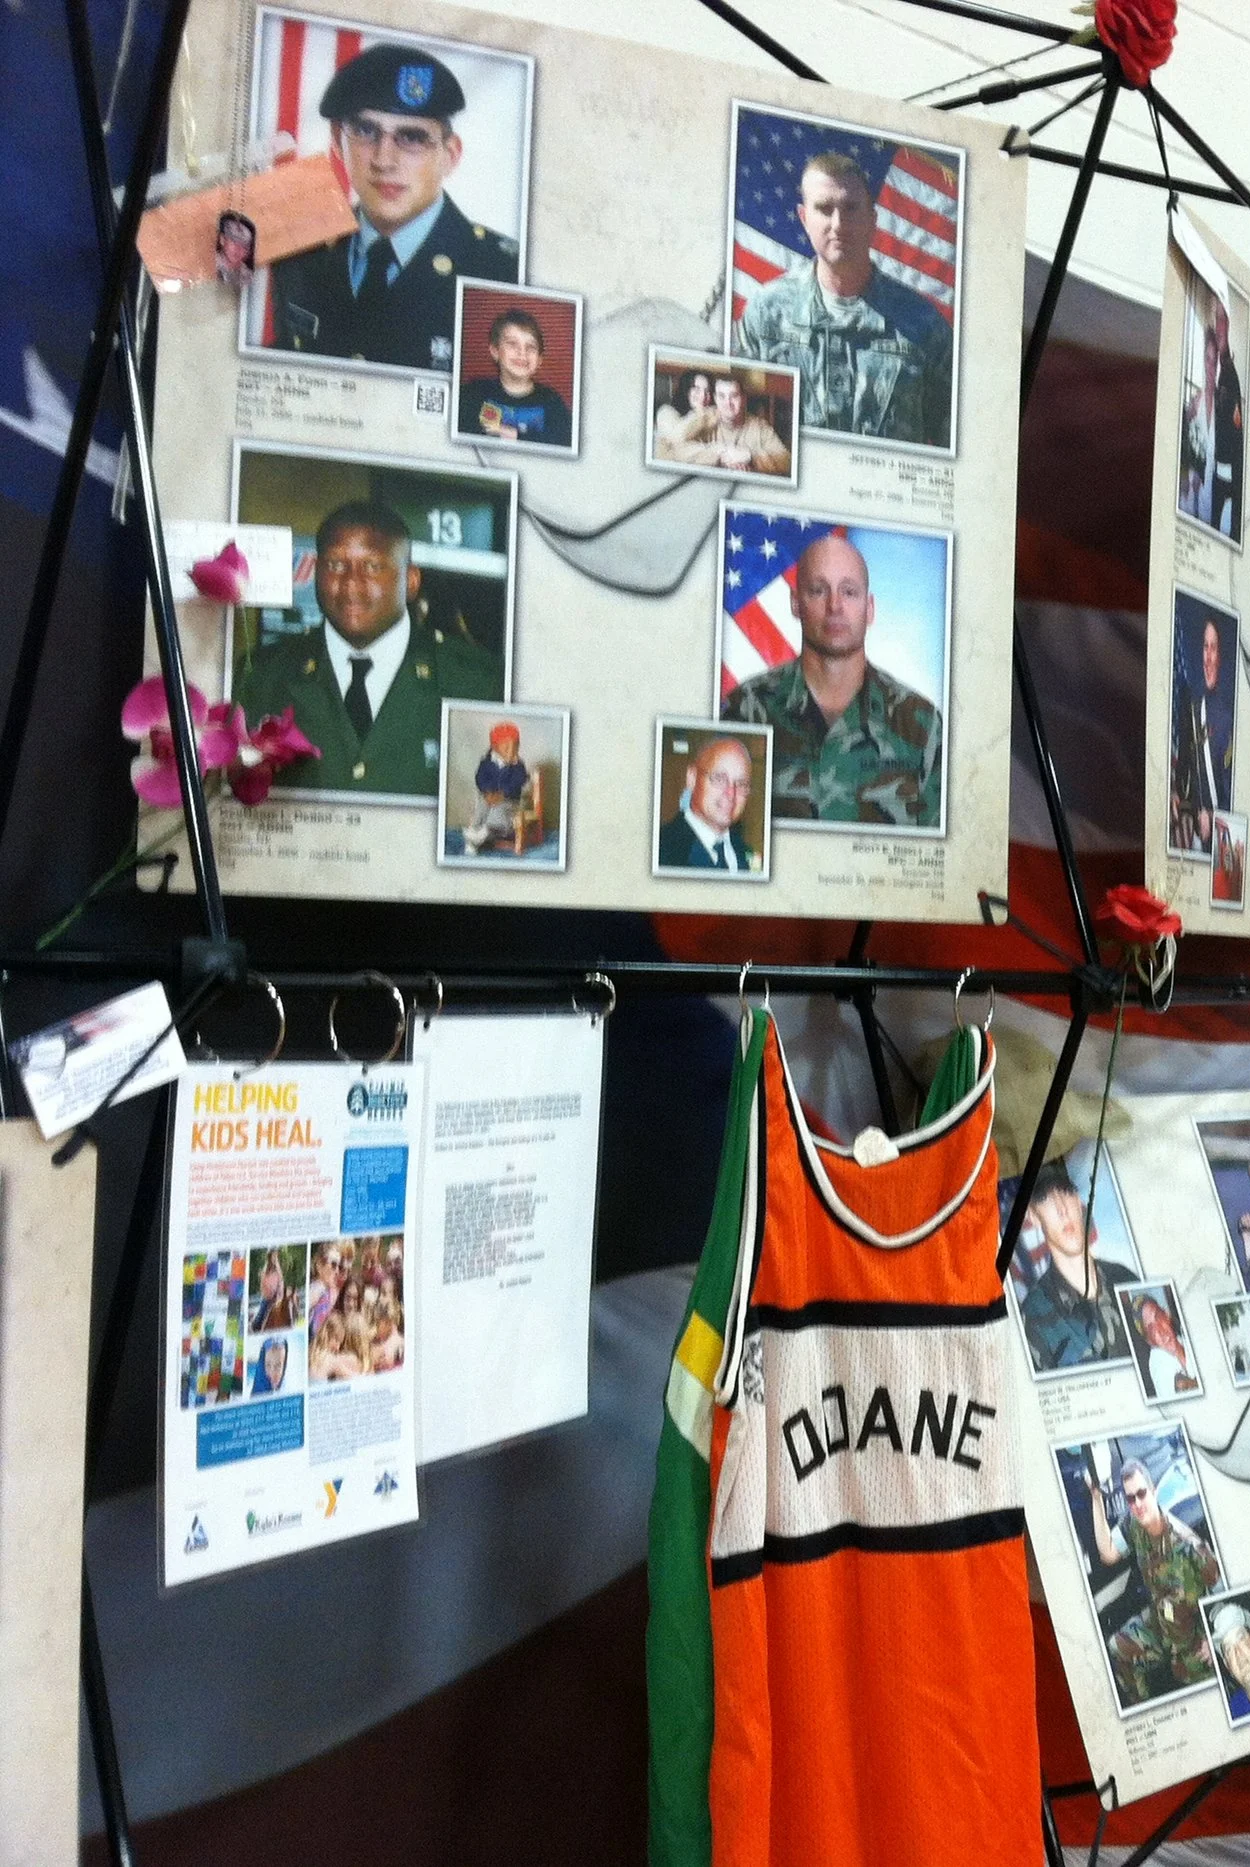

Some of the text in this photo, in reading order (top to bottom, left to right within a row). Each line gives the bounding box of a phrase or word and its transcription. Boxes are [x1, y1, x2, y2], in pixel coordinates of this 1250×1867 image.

[427, 508, 463, 544] 13
[193, 1081, 299, 1115] HELPING
[190, 1117, 323, 1153] KIDS HEAL.
